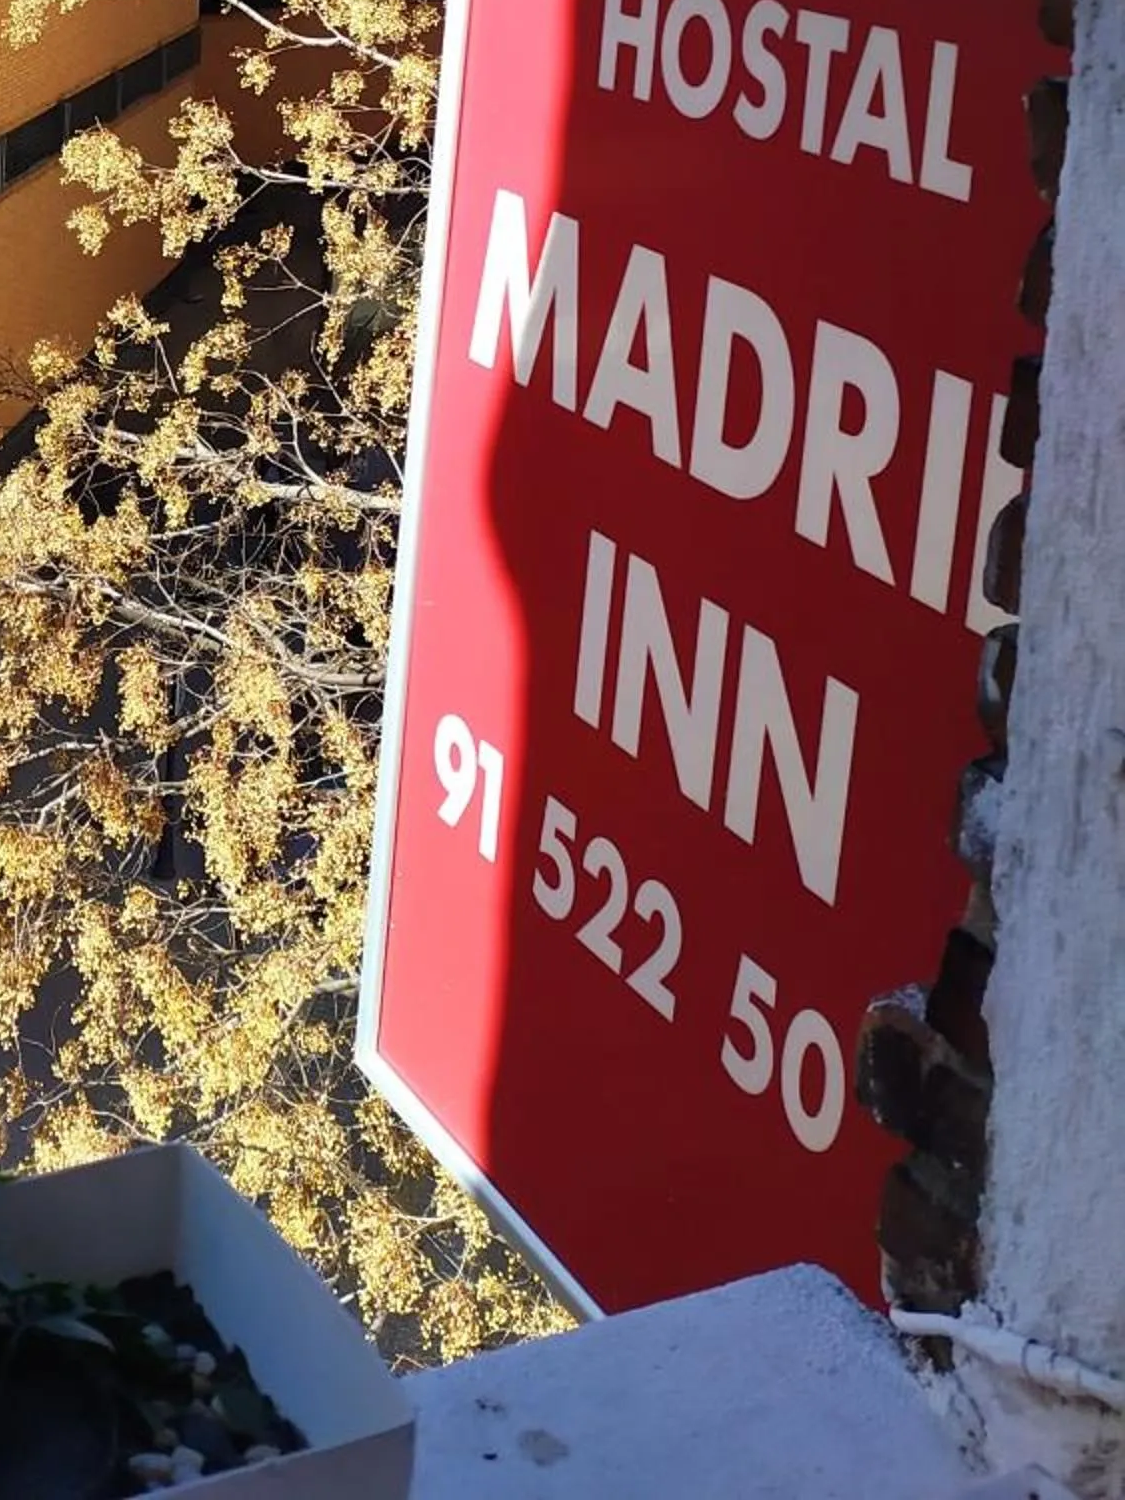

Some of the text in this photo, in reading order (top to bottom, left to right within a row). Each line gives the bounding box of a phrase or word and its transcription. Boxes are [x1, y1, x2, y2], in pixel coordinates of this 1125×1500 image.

[573, 528, 860, 908] INN
[433, 714, 846, 1153] 91 522 50
